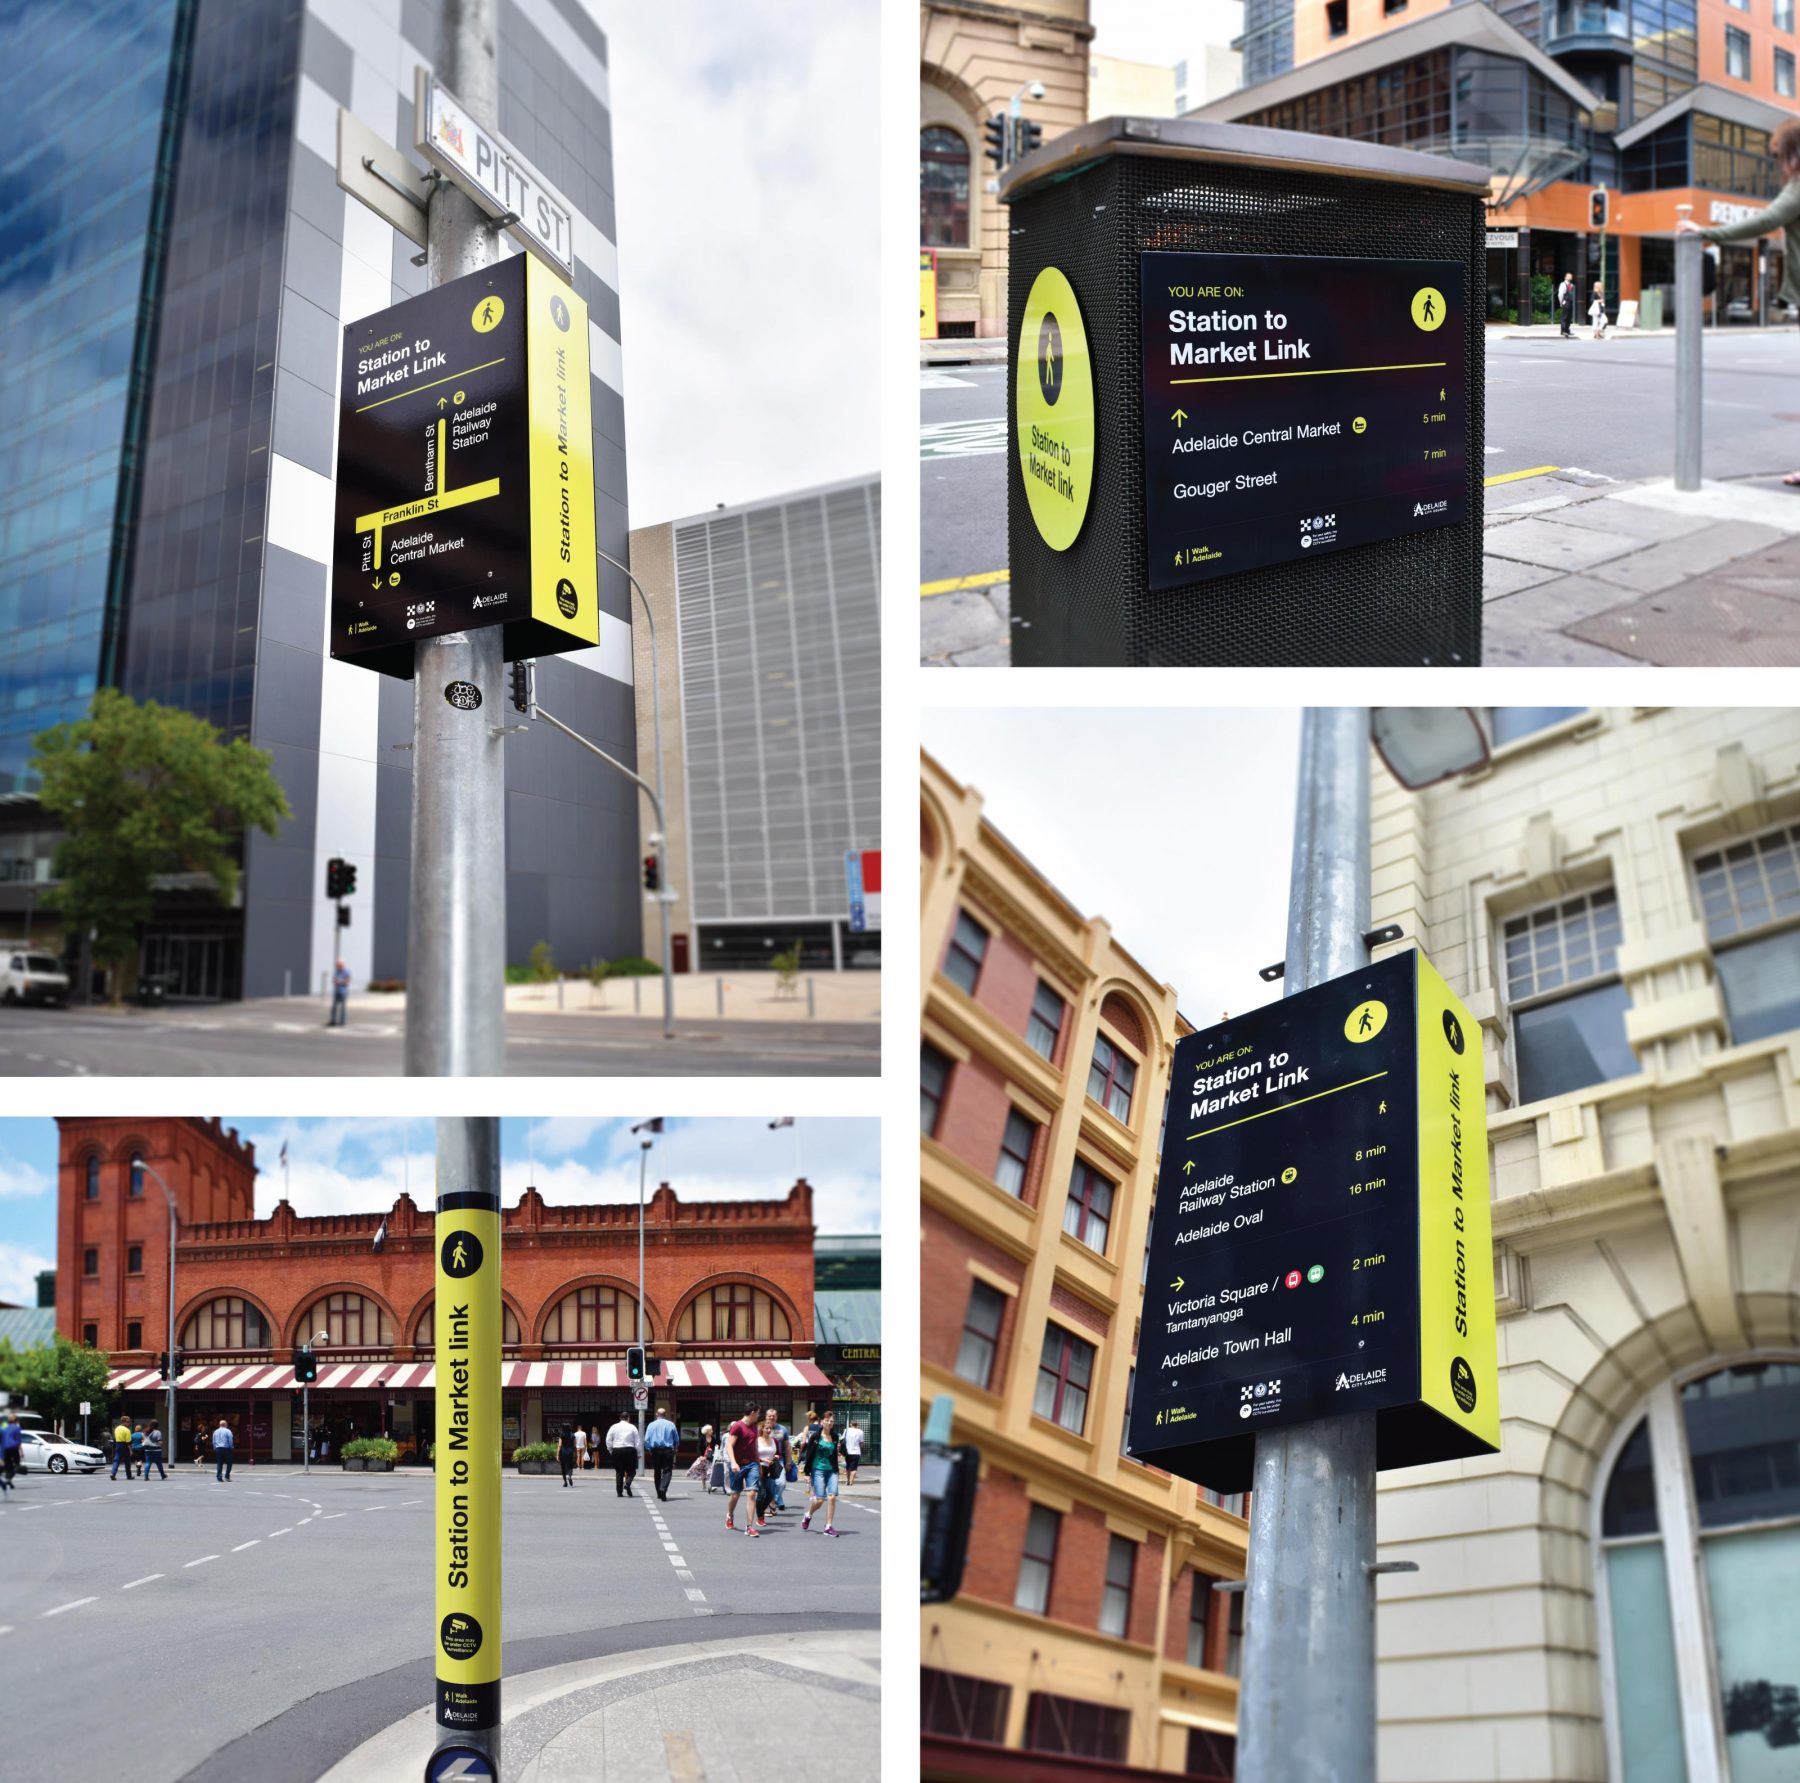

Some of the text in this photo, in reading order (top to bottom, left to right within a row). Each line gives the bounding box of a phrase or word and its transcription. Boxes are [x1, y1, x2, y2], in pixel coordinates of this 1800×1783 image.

[476, 134, 564, 252] PITT ST
[1168, 286, 1244, 297] YOU ARE ON:
[1168, 310, 1288, 332] Station to
[358, 332, 402, 354] YOU ARE ON:
[1170, 338, 1310, 366] Market Link
[358, 339, 430, 375] Station to
[358, 351, 446, 396] Market Link
[452, 402, 496, 424] Adelaide
[1424, 412, 1446, 424] 5 min
[452, 417, 492, 437] Railway
[1172, 421, 1342, 454] Adelaide Central Market
[452, 432, 488, 450] Station
[1032, 424, 1070, 466] Station to
[424, 424, 434, 492] Bentham St
[556, 348, 570, 563] Station to Market link
[1424, 448, 1446, 460] 7 min
[1030, 452, 1074, 502] Market link
[1174, 471, 1278, 499] Gouger Street
[383, 499, 439, 522] Franklin St
[1414, 500, 1448, 516] ADELAIDE
[362, 535, 372, 572] Pitt St
[390, 532, 434, 552] Adelaide
[390, 537, 464, 564] Central Market
[1192, 546, 1208, 554] Walk
[1192, 552, 1222, 562] Adelaide
[472, 592, 508, 609] ADELAIDE
[1196, 1045, 1254, 1072] YOU ARE ON:
[1192, 1052, 1288, 1096] Station to
[1190, 1066, 1310, 1120] Market Link
[1356, 1145, 1386, 1160] 8 min
[1179, 1178, 1275, 1214] Railway Station
[1180, 1174, 1234, 1199] Adelaide
[1349, 1178, 1386, 1195] 16 min
[1449, 1068, 1467, 1338] Station to Market link
[1175, 1209, 1264, 1246] Adelaide Oval
[1352, 1254, 1385, 1270] 2 min
[1168, 1294, 1216, 1316] Victoria
[1220, 1282, 1268, 1304] Square
[1352, 1310, 1384, 1326] 4 min
[1161, 1327, 1292, 1370] Adelaide Town Hall
[1335, 1368, 1386, 1391] ADELAIDE
[1170, 1412, 1197, 1422] Adelaide
[1171, 1407, 1186, 1415] Walk
[448, 1304, 468, 1588] Station to Market link
[445, 1708, 478, 1720] ADELAIDE
